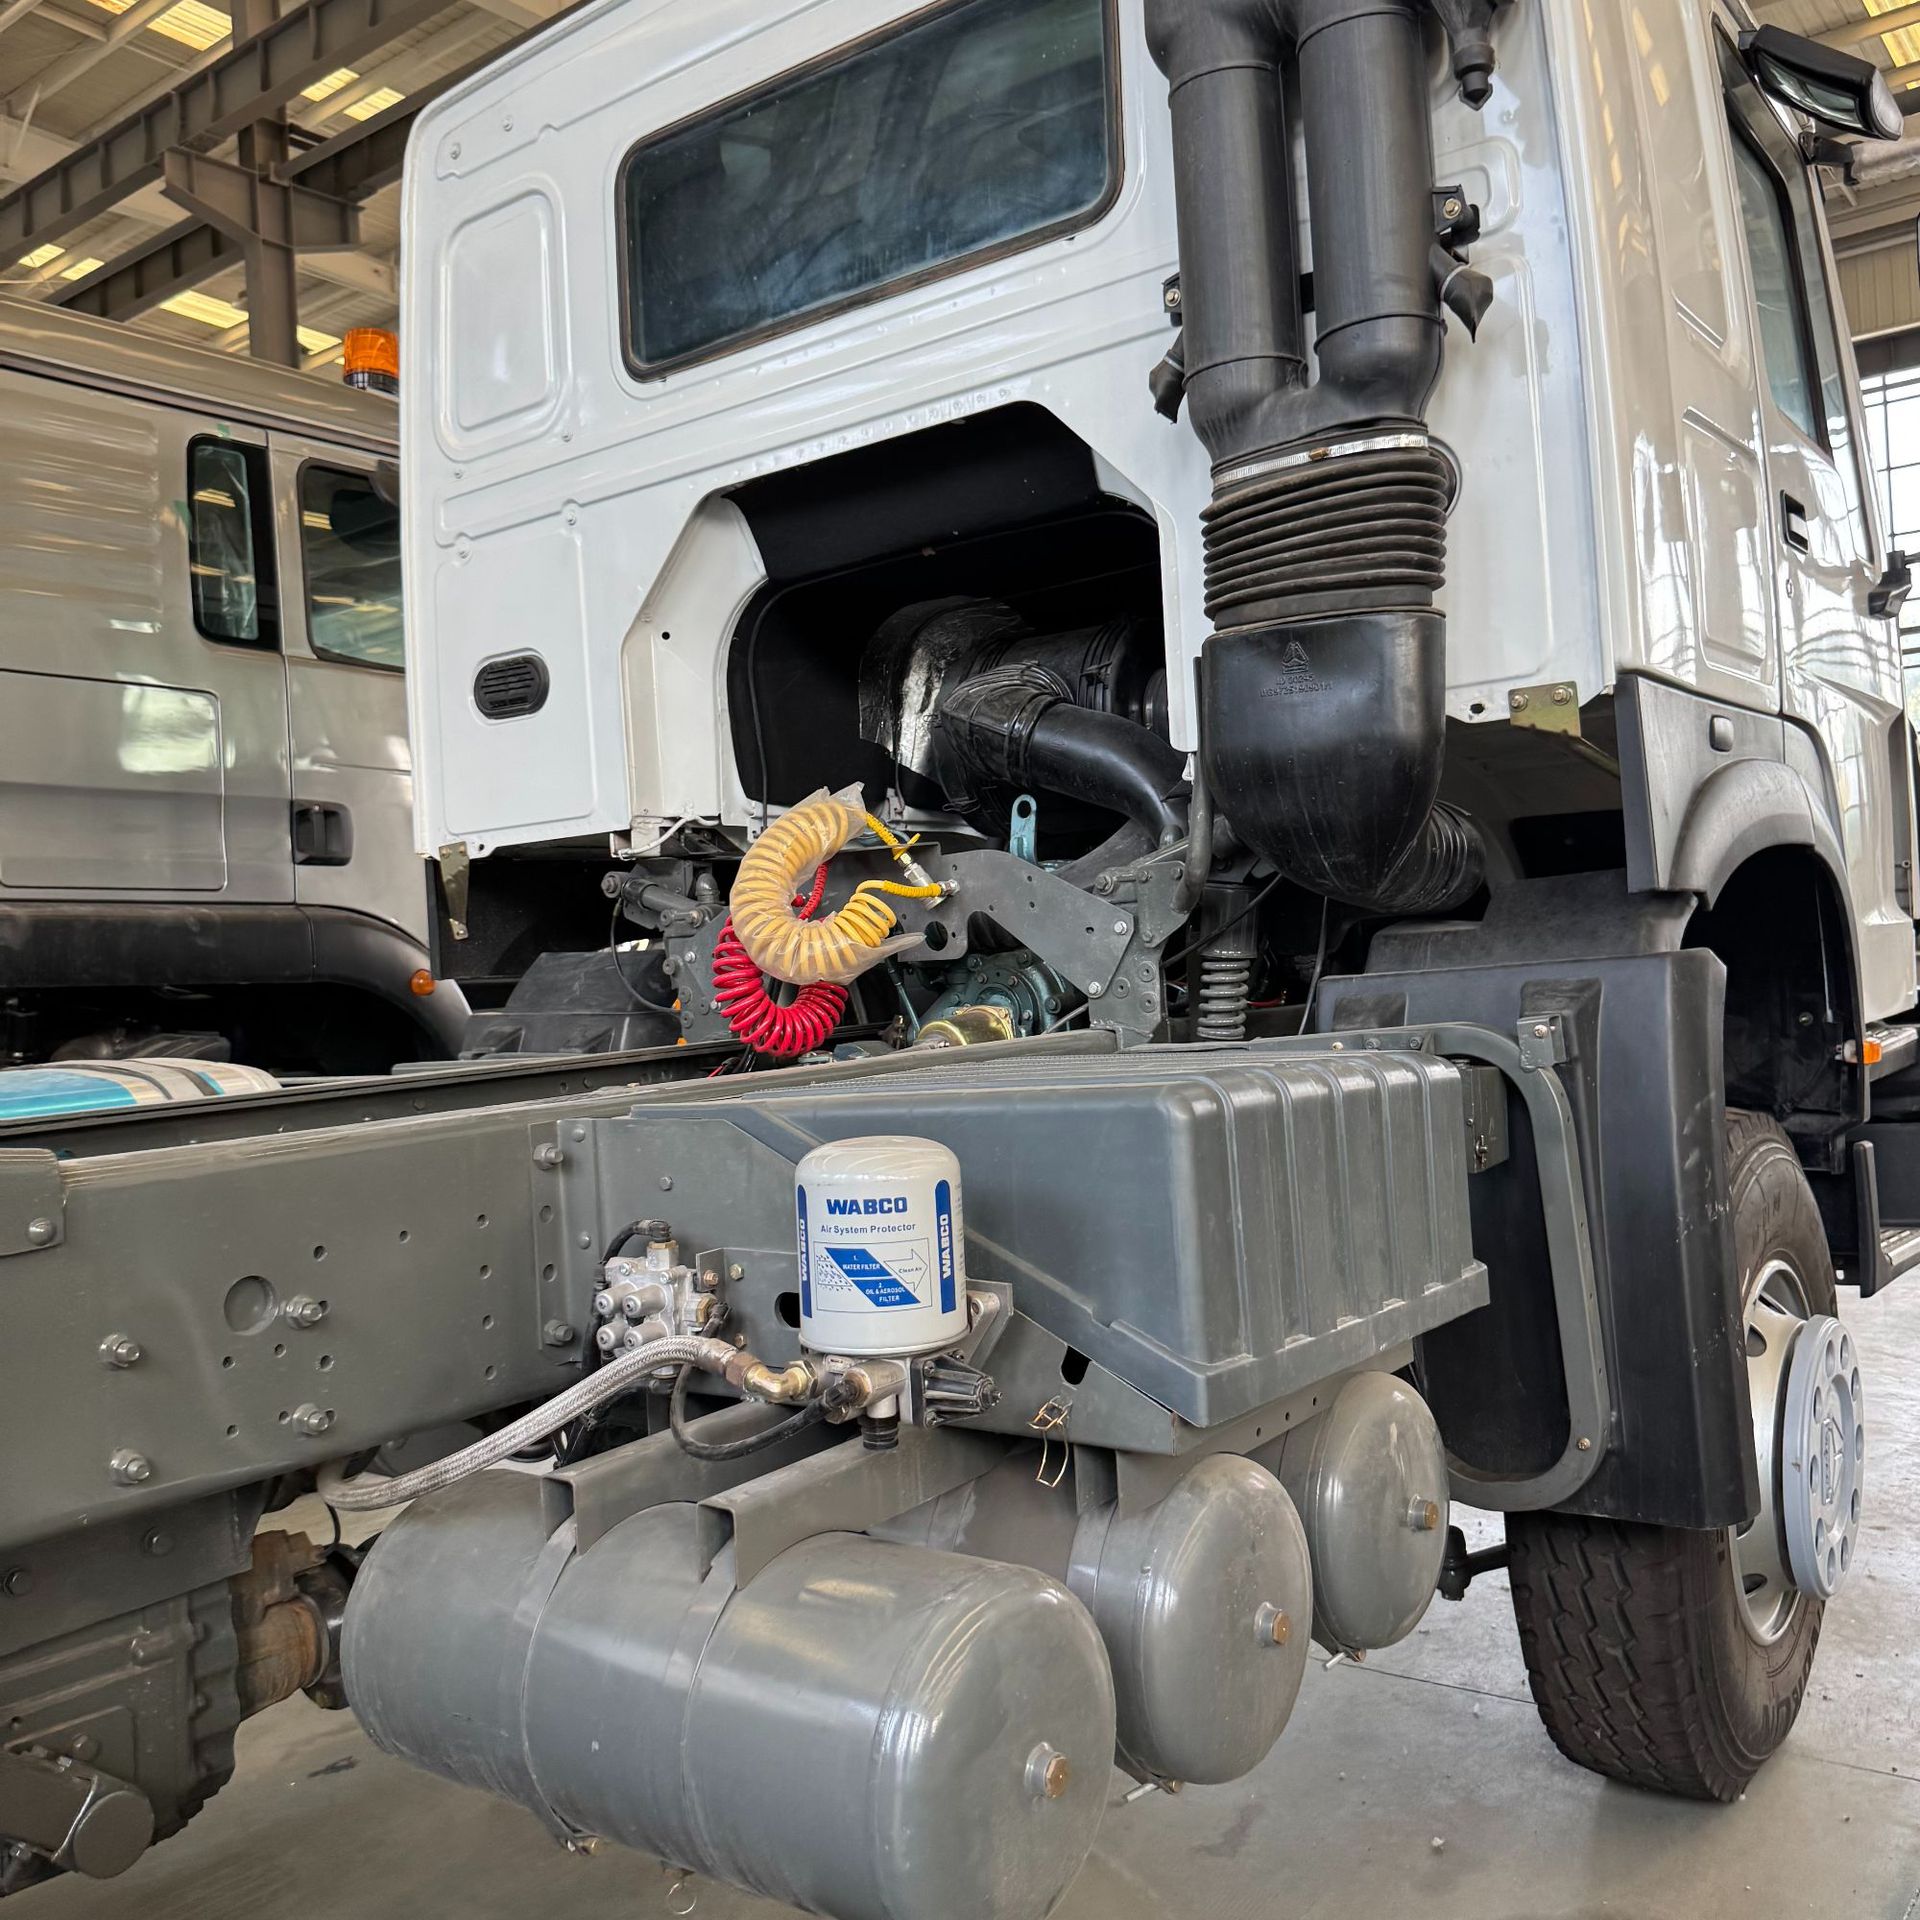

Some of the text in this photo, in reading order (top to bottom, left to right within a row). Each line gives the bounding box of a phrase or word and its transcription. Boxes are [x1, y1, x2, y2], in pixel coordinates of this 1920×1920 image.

[826, 1197, 908, 1215] WABCO
[820, 1223, 916, 1236] Air System Protector
[940, 1213, 952, 1279] WABCO
